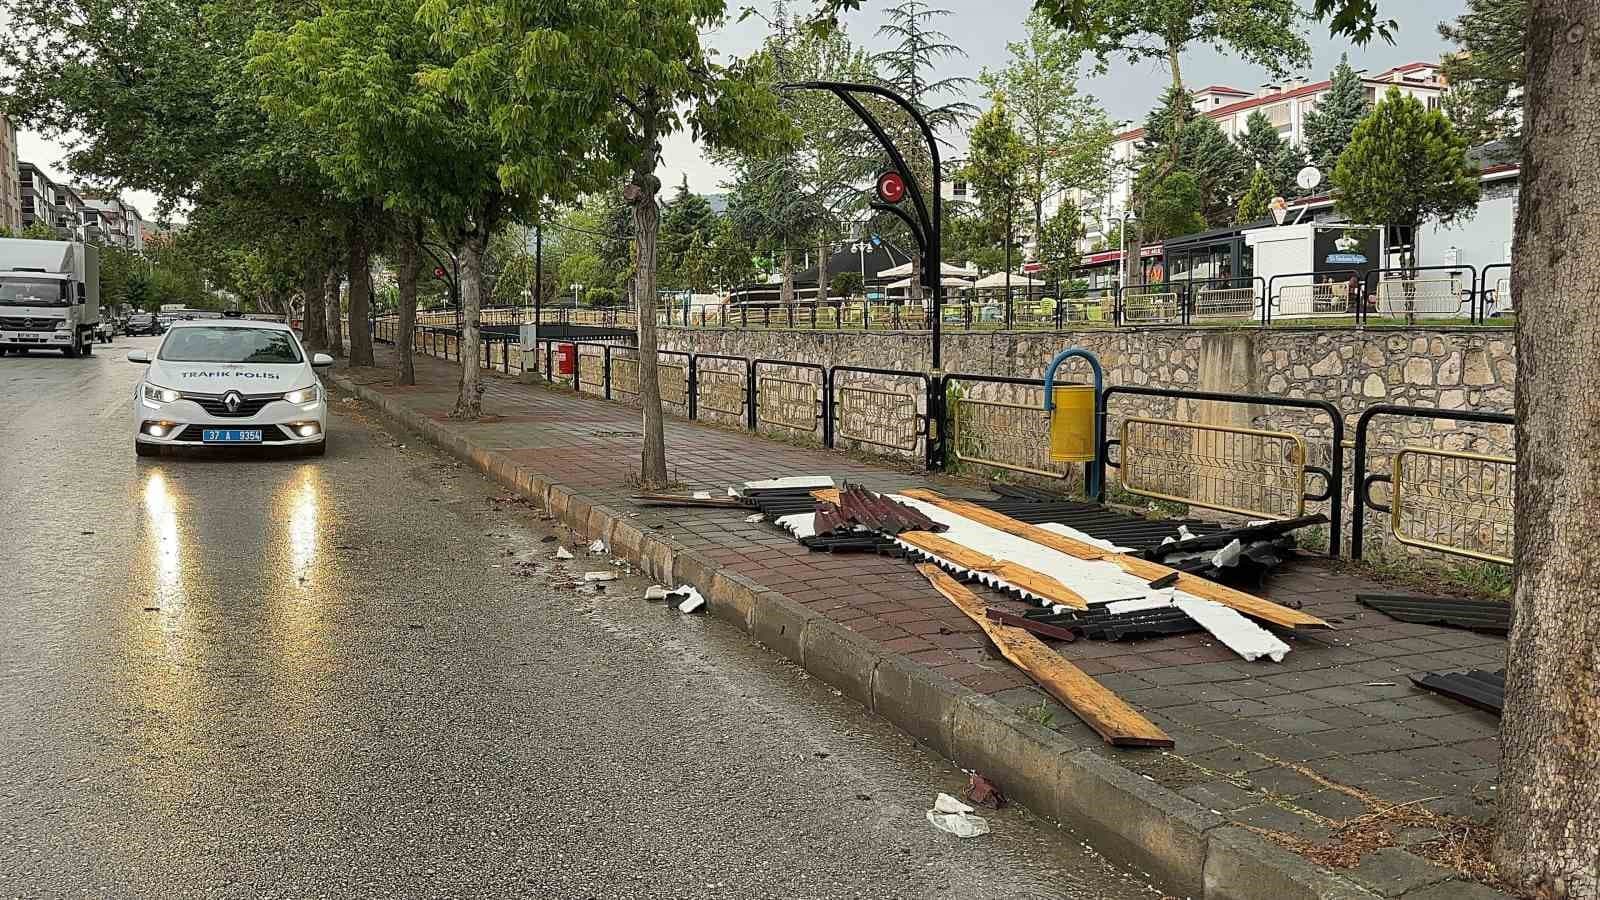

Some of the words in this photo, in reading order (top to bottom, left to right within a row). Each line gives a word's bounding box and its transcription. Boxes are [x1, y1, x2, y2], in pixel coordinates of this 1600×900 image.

[209, 431, 219, 440] 37
[225, 431, 231, 440] A
[239, 431, 260, 440] 9354
